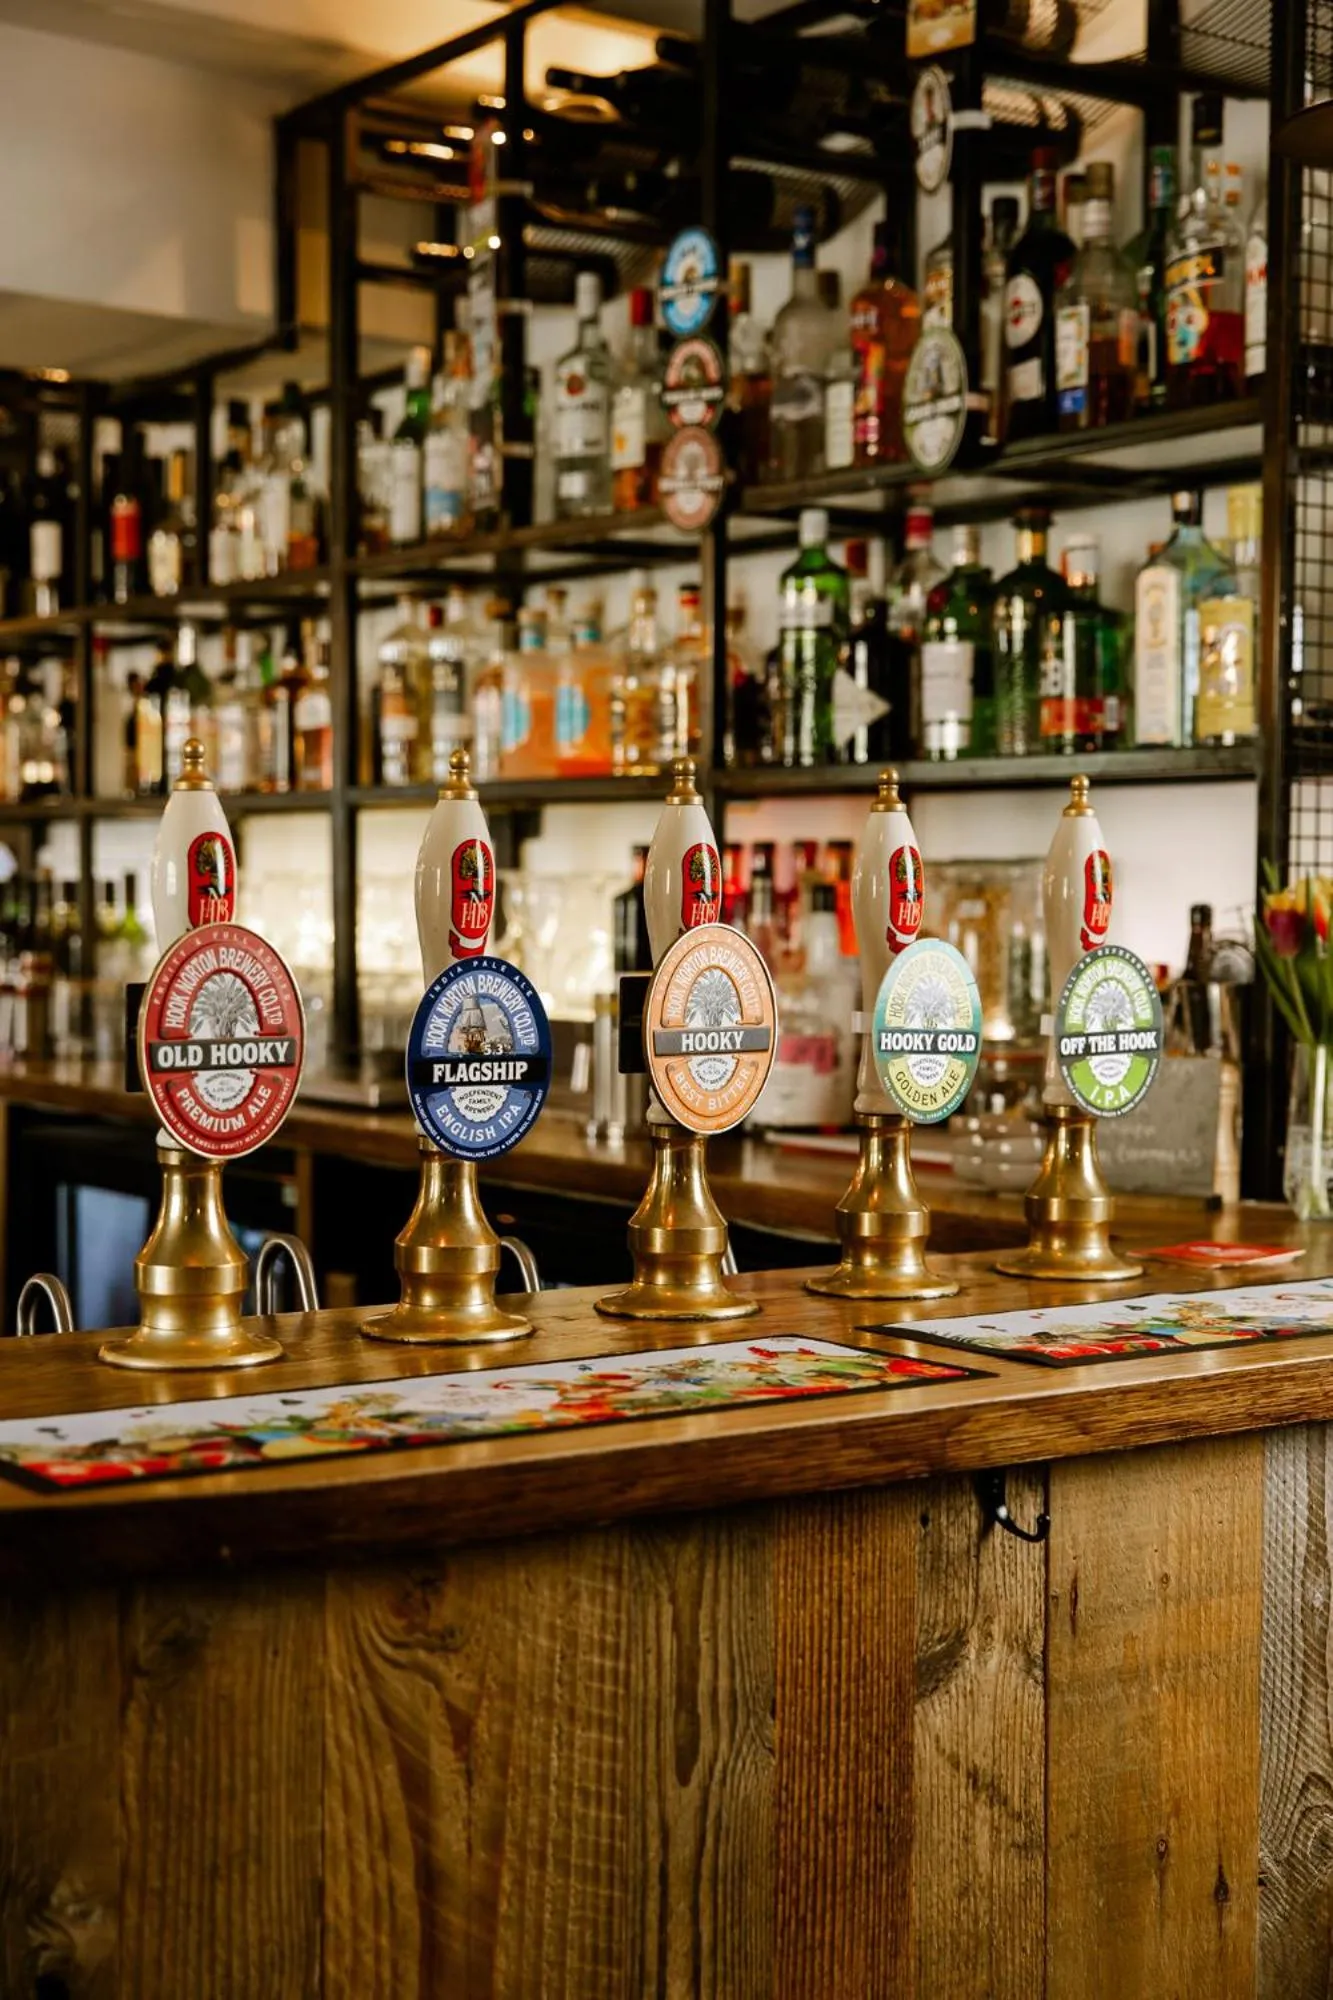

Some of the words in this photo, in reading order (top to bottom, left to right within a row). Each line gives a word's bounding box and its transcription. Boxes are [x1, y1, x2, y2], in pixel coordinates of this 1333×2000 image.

[212, 931, 248, 945] FULL
[175, 948, 219, 995] NORTON
[218, 946, 273, 990] BREWERY
[429, 966, 463, 999] INDIA
[472, 960, 508, 973] PALE
[513, 975, 533, 998] ALE
[676, 947, 709, 988] NORTON
[164, 992, 190, 1028] HOOK
[437, 975, 477, 1018] NORTON
[477, 974, 526, 1014] BREWERY
[667, 986, 686, 1018] HOOK
[425, 1015, 451, 1048] HOOK
[681, 1031, 744, 1052] HOOKY
[880, 1032, 934, 1050] HOOKY
[937, 1033, 977, 1052] GOLD
[1060, 1036, 1086, 1055] OFF
[1087, 1034, 1117, 1053] THE
[1118, 1031, 1158, 1051] HOOK
[157, 1044, 204, 1068] OLD
[210, 1041, 290, 1066] HOOKY
[432, 1061, 529, 1084] FLAGSHIP
[674, 1070, 704, 1107] BEST
[708, 1068, 751, 1110] BITTER
[895, 1071, 938, 1106] GOLDEN
[942, 1069, 960, 1098] ALE
[176, 1087, 247, 1133] PREMIUM
[247, 1084, 273, 1118] ALE
[435, 1103, 497, 1142] ENGLISH
[498, 1103, 522, 1130] IPA
